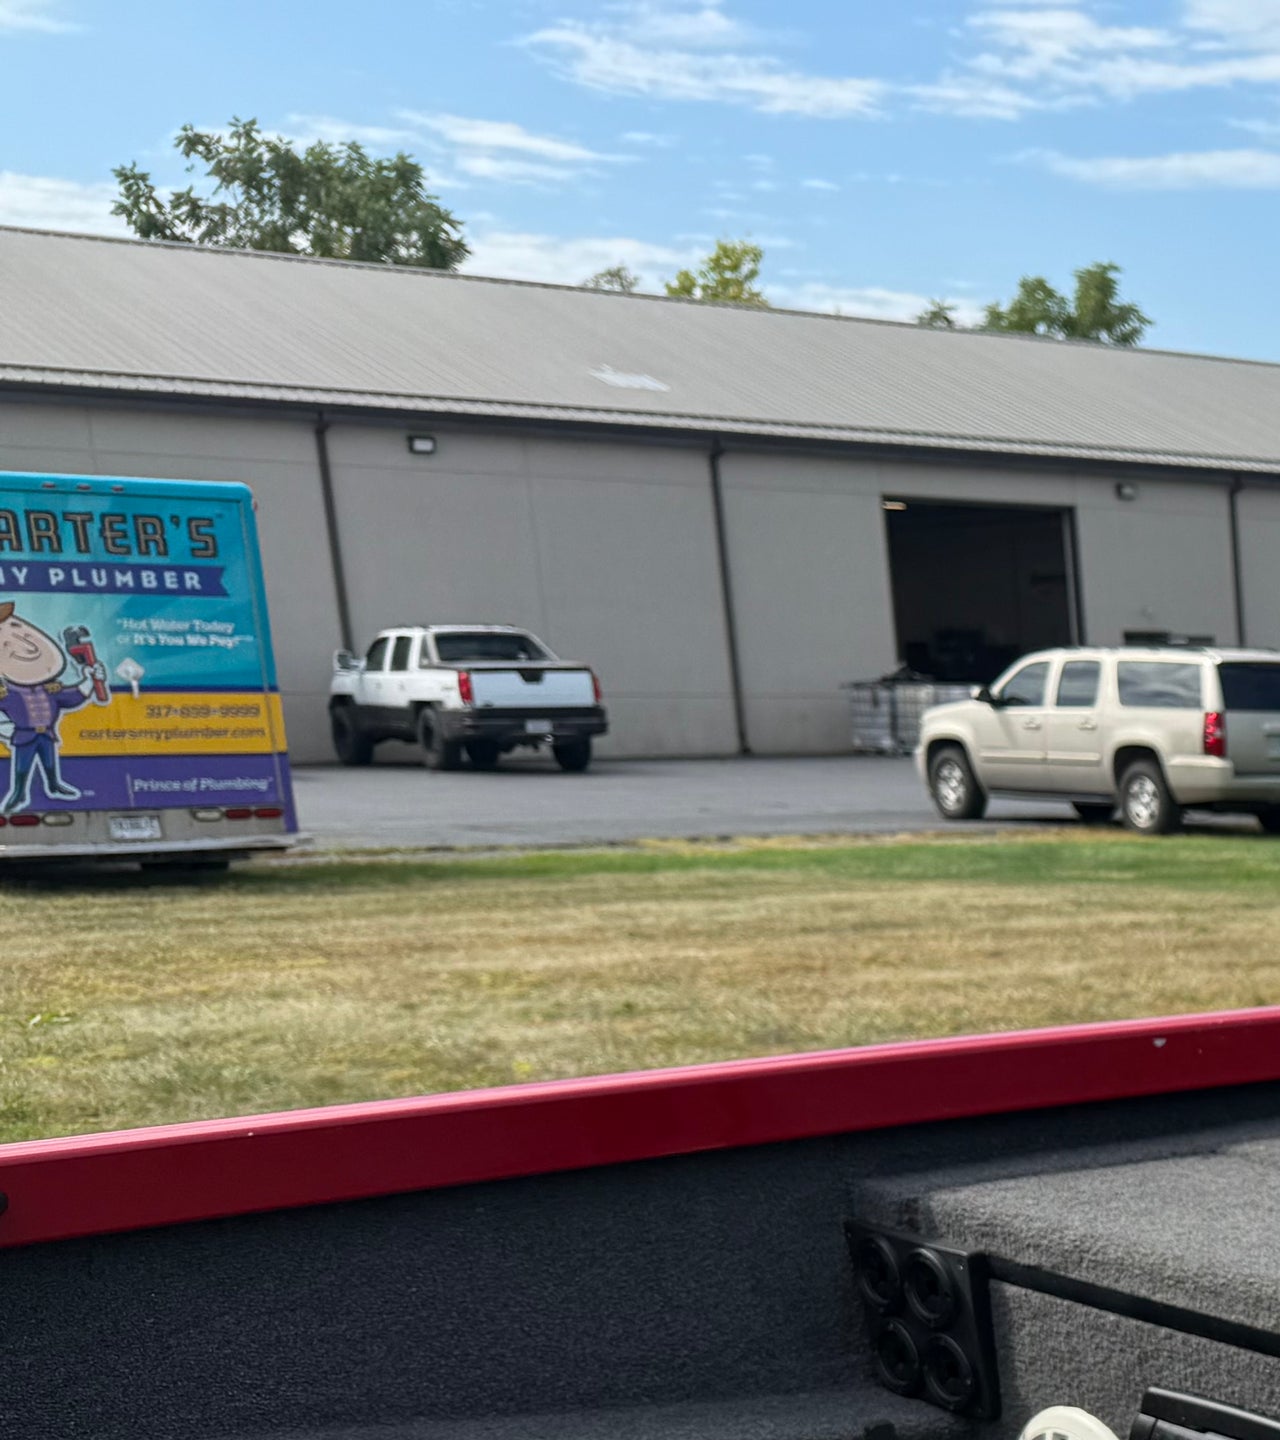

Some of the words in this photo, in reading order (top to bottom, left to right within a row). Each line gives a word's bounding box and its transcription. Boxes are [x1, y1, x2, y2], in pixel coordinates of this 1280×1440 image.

[0, 566, 28, 586] Y
[49, 567, 202, 589] PLUMBER
[133, 778, 181, 792] Prince
[182, 777, 198, 792] of
